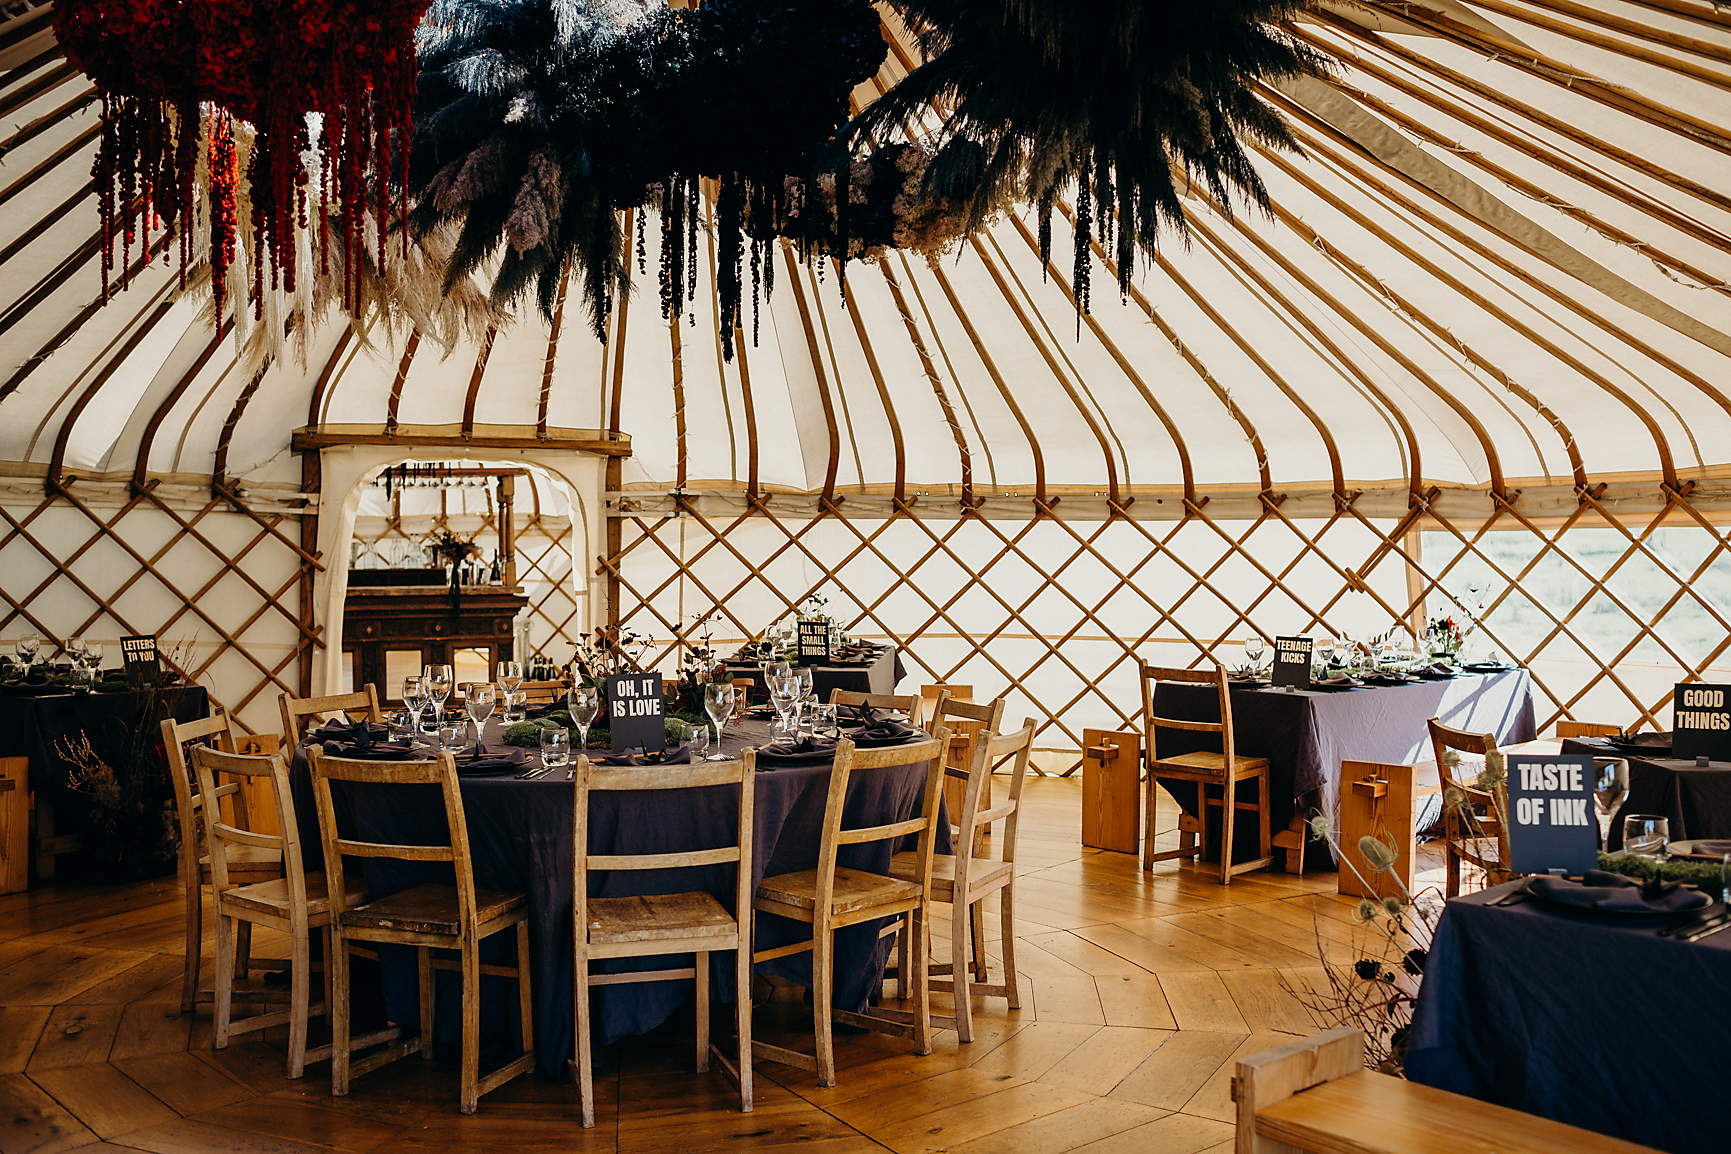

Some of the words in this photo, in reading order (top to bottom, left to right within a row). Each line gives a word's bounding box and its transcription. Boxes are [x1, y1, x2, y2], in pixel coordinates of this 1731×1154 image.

[800, 625, 813, 635] ALL
[814, 625, 827, 635] THE
[123, 638, 155, 651] LETTERS
[802, 635, 826, 645] SMALL
[1276, 639, 1312, 652] TEENAGE
[127, 651, 138, 663] TO
[139, 650, 155, 662] YOU
[802, 646, 826, 656] THINGS
[1280, 653, 1305, 664] KICKS
[616, 679, 639, 698] OH,
[642, 678, 654, 696] IT
[1683, 689, 1724, 708] GOOD
[613, 702, 626, 718] IS
[629, 698, 661, 716] LOVE
[1676, 711, 1730, 730] THINGS
[1517, 763, 1583, 792] TASTE
[1516, 798, 1544, 825] OF
[1550, 798, 1589, 827] INK
